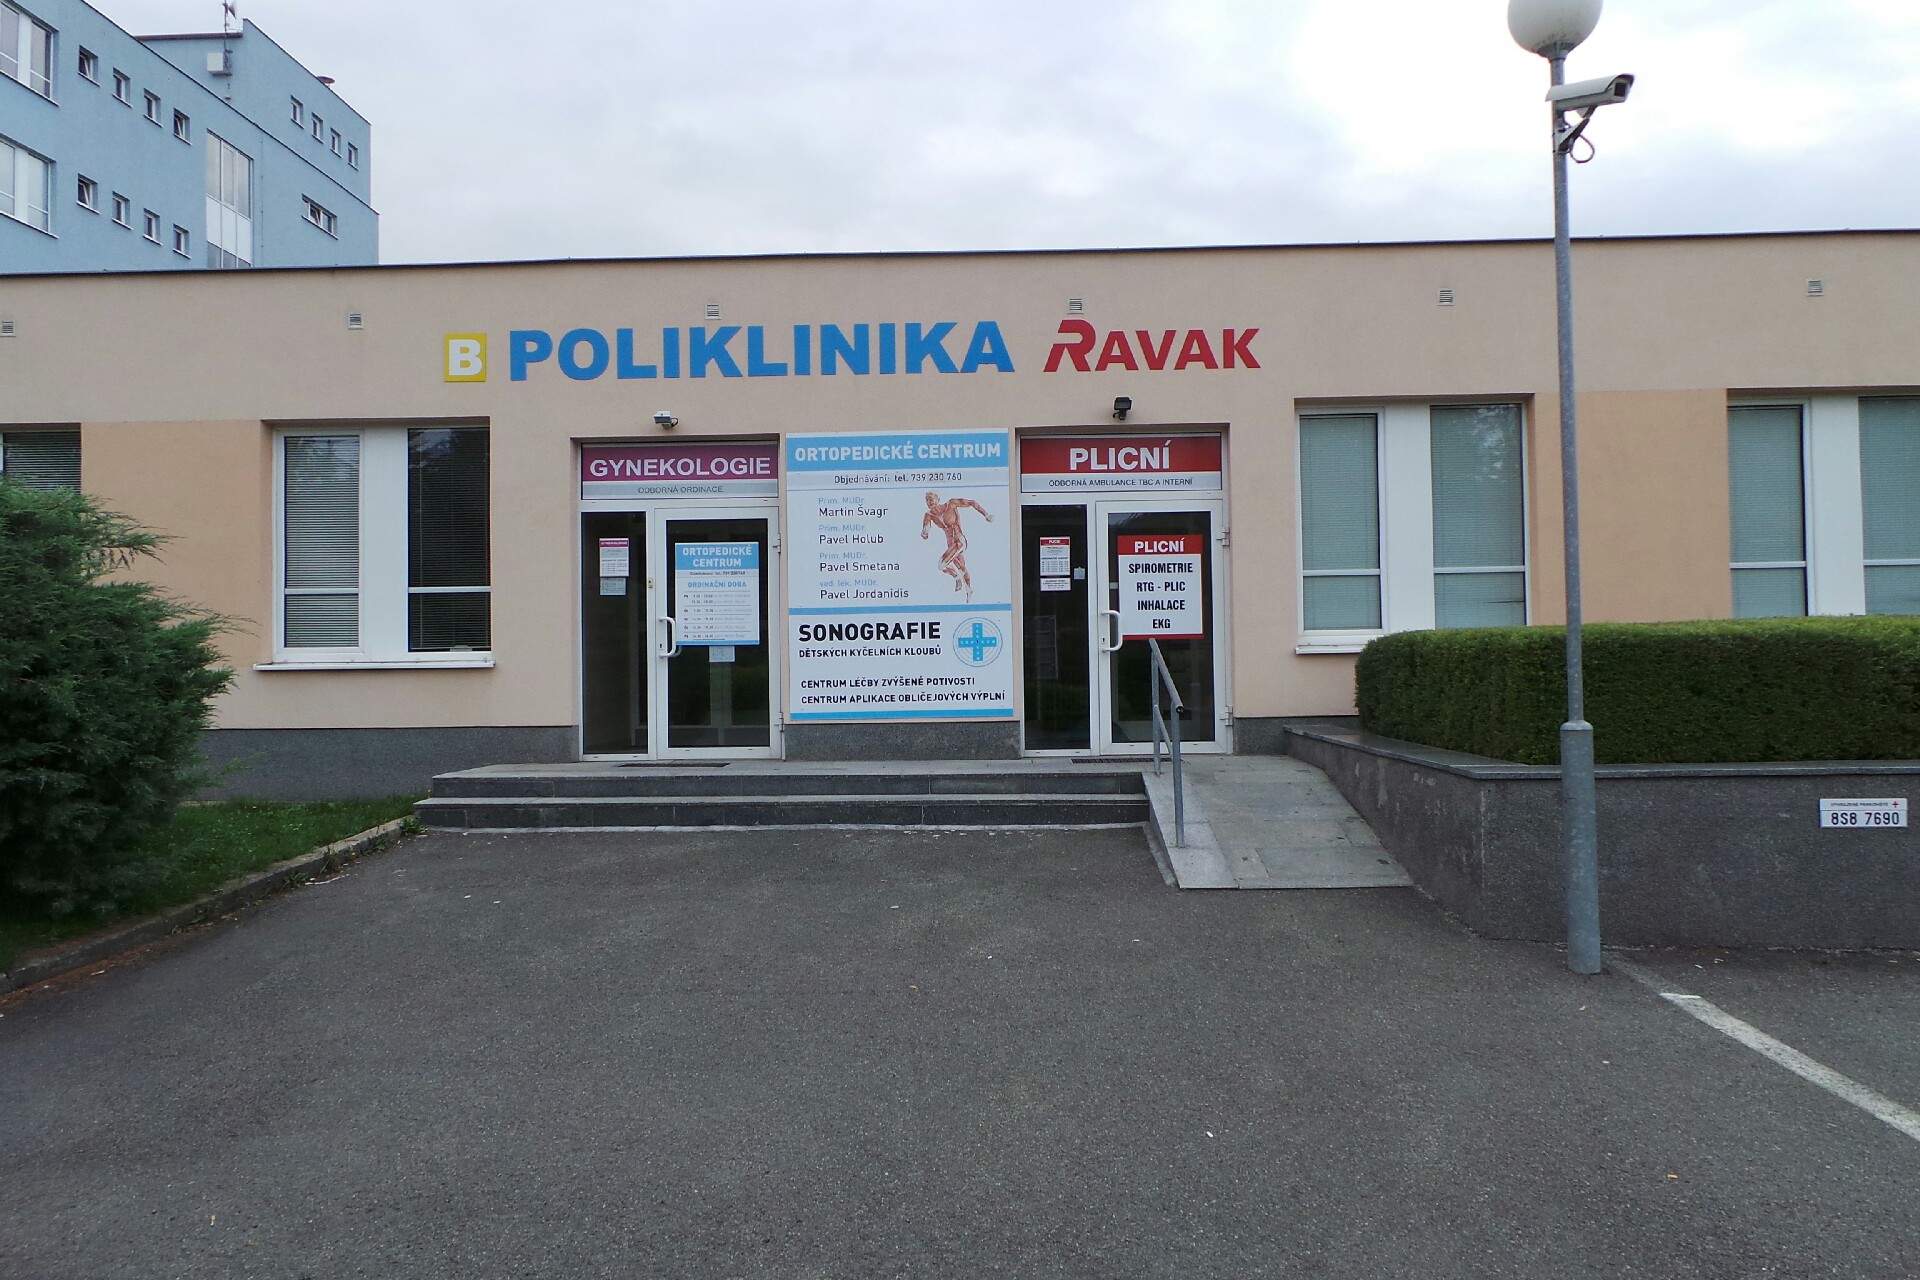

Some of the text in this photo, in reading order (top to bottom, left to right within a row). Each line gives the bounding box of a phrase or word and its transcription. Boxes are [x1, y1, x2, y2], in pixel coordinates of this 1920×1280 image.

[448, 319, 1261, 382] B POLIKLINIKA RAVAK
[795, 440, 1000, 462] ORTOPEDICKÉ CENTRUM
[1069, 439, 1172, 471] PLICNÍ
[589, 457, 771, 477] GYNEKOLOGIE
[834, 472, 962, 484] Objednávání: tel. 739 230 760
[1048, 478, 1087, 487] ODBORNÁ
[1139, 478, 1154, 486] TBC
[1154, 478, 1161, 486] A
[1163, 477, 1193, 486] INTERNÍ
[637, 485, 723, 494] ODBORNÁ ORDINACE
[819, 504, 888, 518] Martin Švagr
[819, 534, 884, 545] Pavel Holub
[1134, 537, 1185, 553] PLICNÍ
[682, 544, 753, 556] ORTOPEDICKÉ
[692, 558, 742, 567] CENTRUM
[820, 562, 900, 572] Pavel Smetana
[1128, 562, 1193, 574] SPIROMETRIE
[1136, 581, 1154, 592] RTG
[1164, 581, 1186, 592] PLIC
[820, 588, 909, 600] Pavel Jordanidis
[1137, 600, 1186, 611] INHALACE
[1152, 618, 1171, 629] EKG
[798, 621, 941, 642] SONOGRAFIE
[799, 644, 942, 658] DĚTSKÝCH KYČELNÍCH KLOUBŮ
[801, 675, 975, 689] CENTRUM LÉČBY ZVÝŠENÉ POTIVOSTI
[801, 689, 1005, 704] CENTRUM APLIKACE OBLIČEJOVÝCH VÝPLNÍ
[1831, 812, 1900, 826] 8S8 7690
